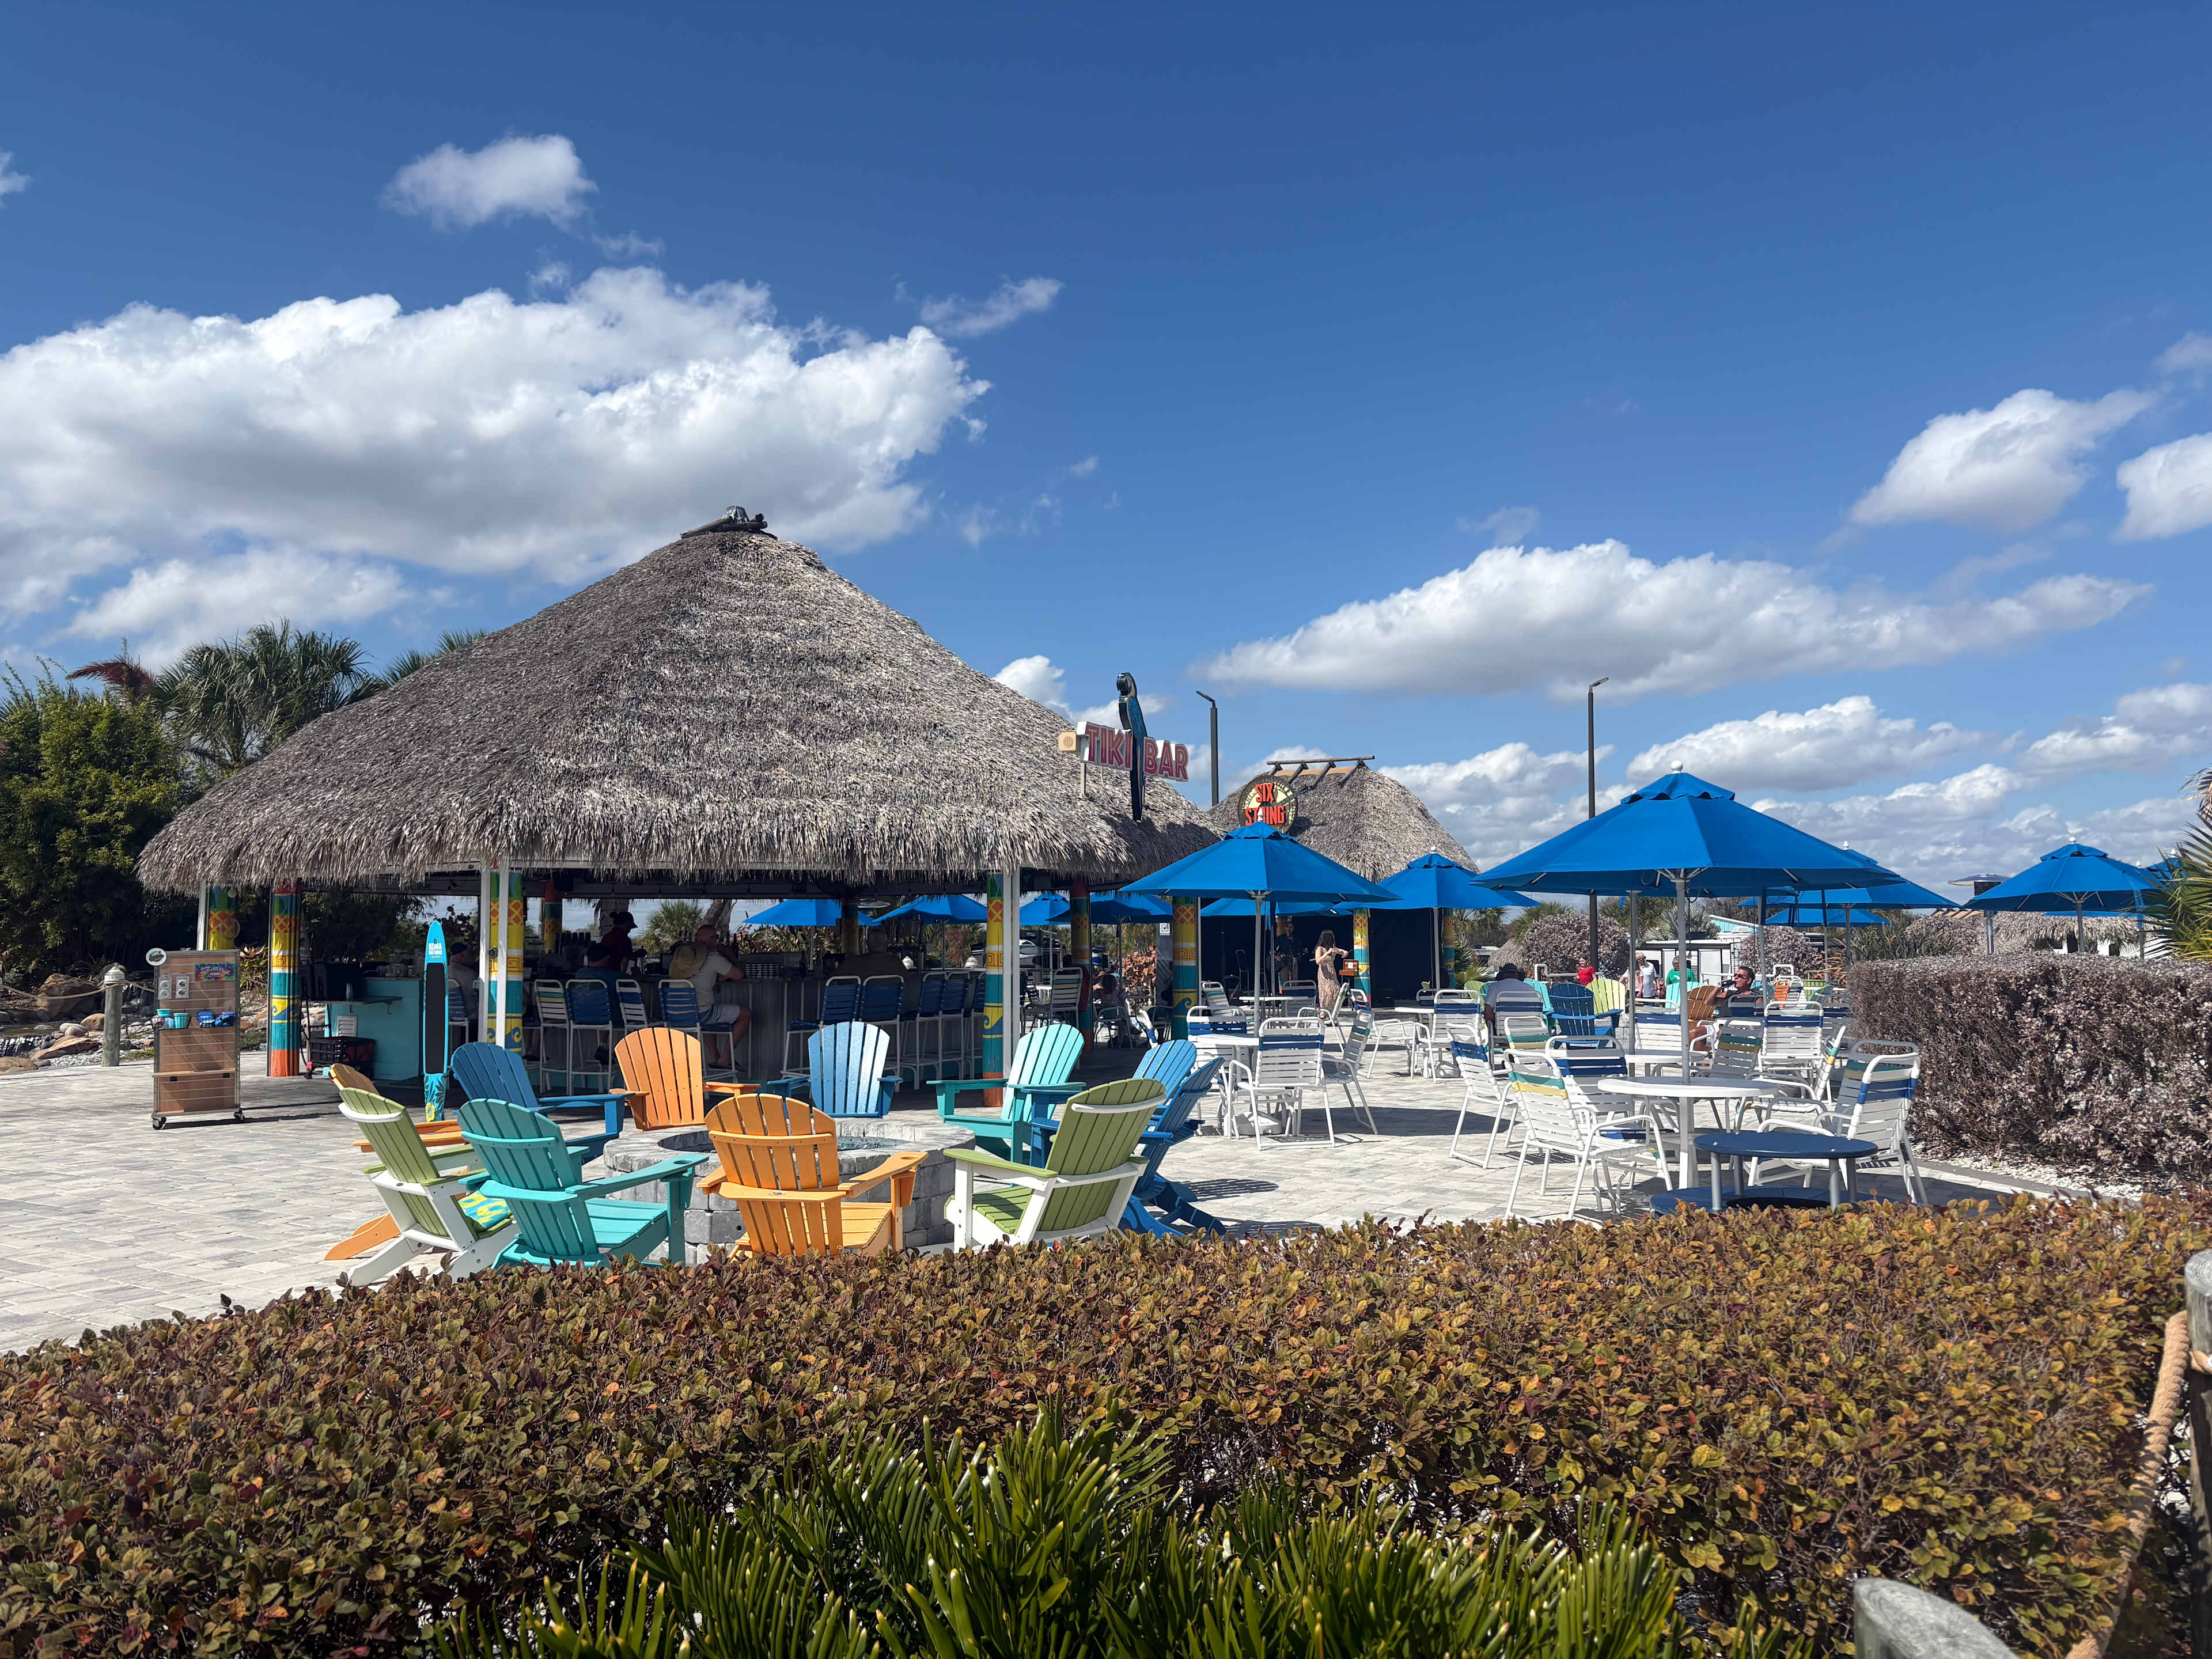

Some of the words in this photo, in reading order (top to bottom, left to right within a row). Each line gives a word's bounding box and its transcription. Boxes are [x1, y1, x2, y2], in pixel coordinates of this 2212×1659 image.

[1085, 724, 1132, 768] TIKI
[1144, 738, 1188, 779] BAR
[1255, 783, 1275, 803] SIX
